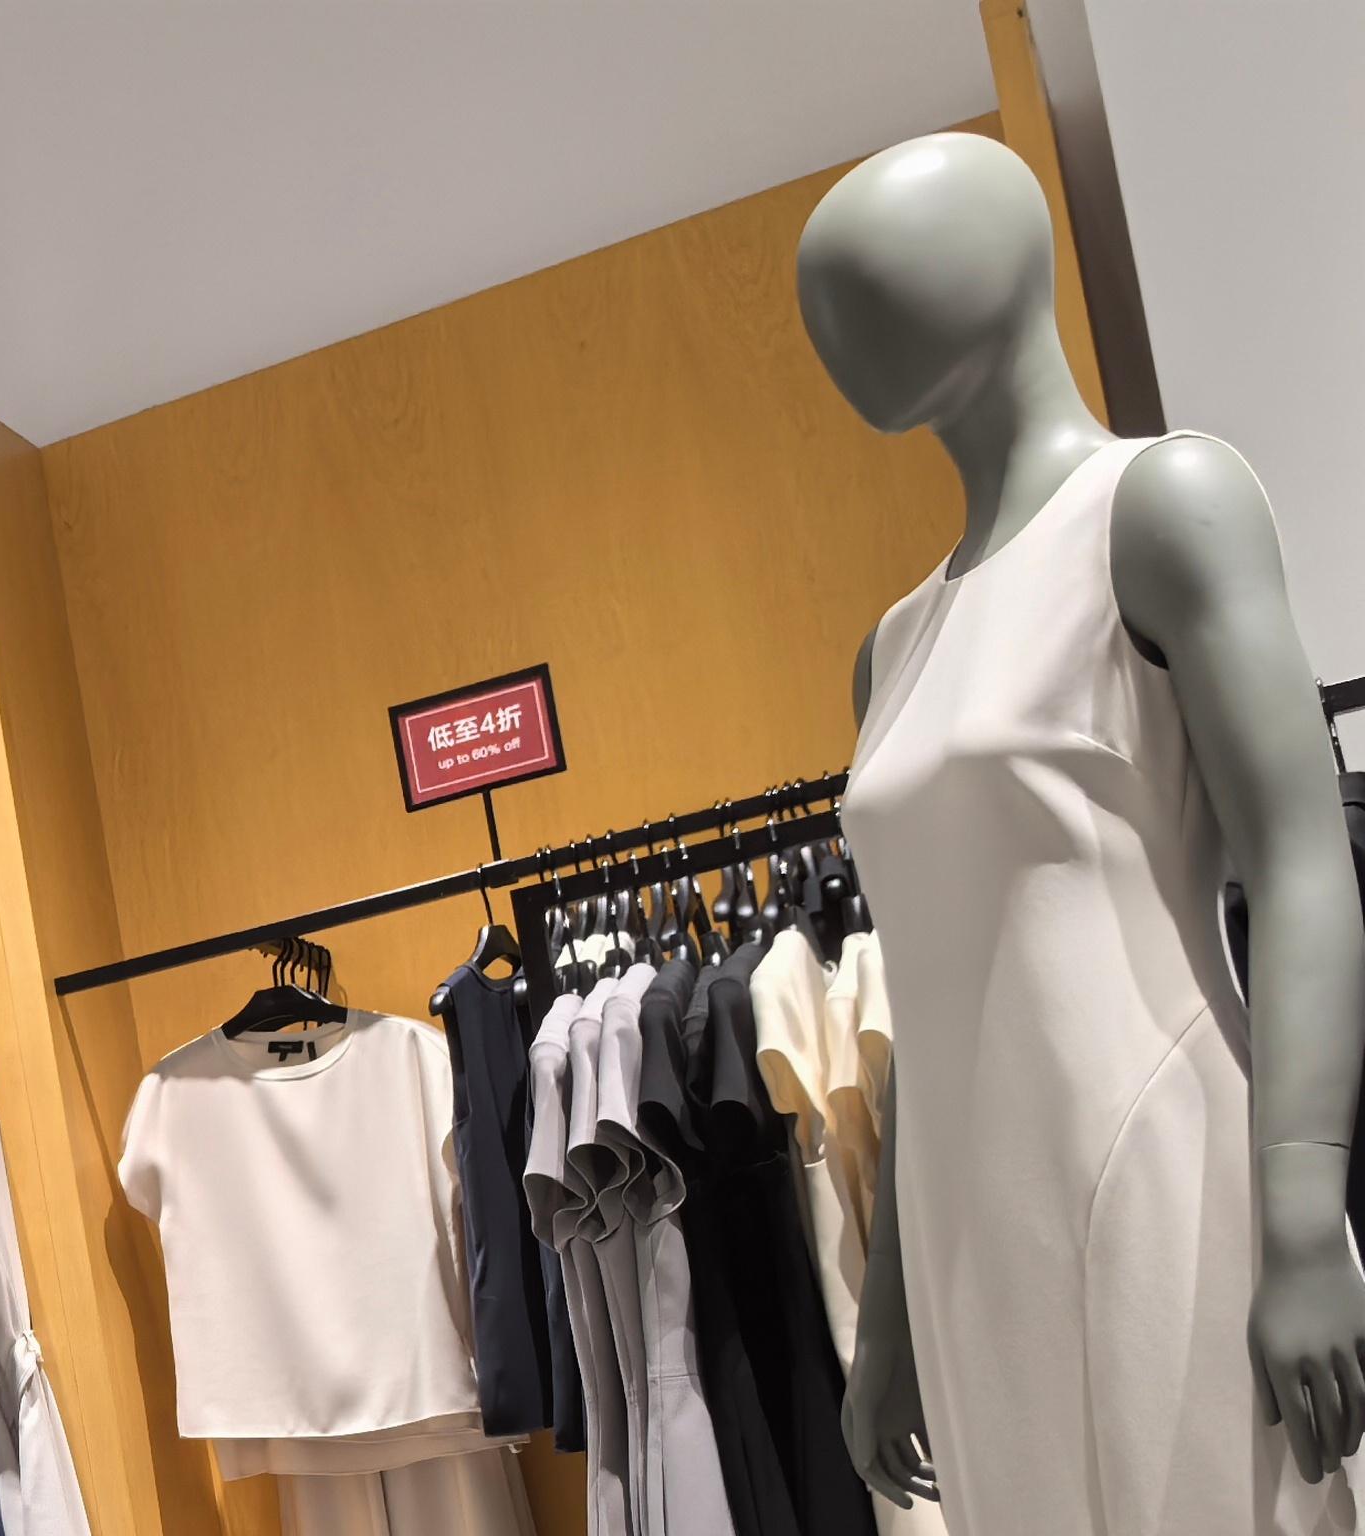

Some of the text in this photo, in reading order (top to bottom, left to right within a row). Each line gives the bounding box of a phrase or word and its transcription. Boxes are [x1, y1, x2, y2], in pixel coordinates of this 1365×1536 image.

[427, 704, 522, 752] 低至4折
[438, 758, 454, 769] up
[457, 754, 470, 765] to
[504, 736, 521, 752] off
